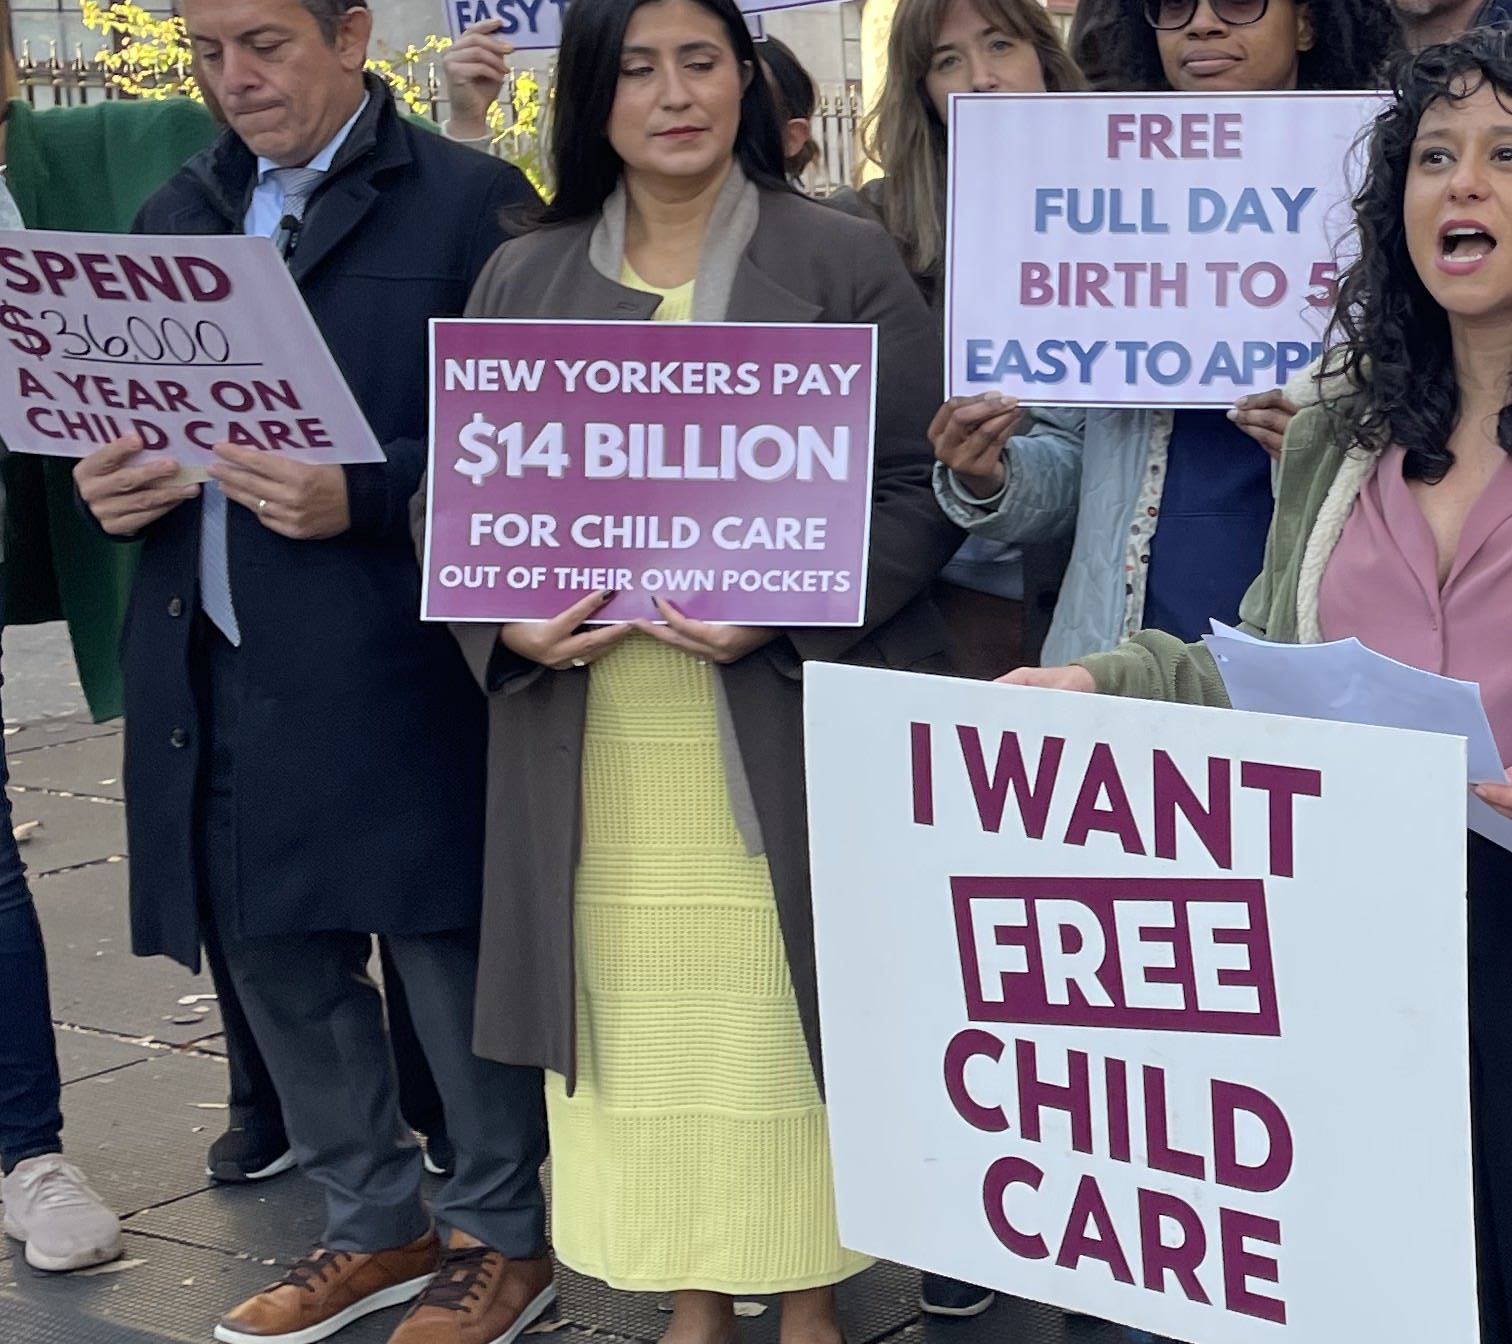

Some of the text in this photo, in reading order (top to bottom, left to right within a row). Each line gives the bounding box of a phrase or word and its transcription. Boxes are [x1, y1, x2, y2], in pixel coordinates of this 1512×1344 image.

[1107, 112, 1244, 160] FREE
[1034, 186, 1316, 235] FULL DAY
[0, 247, 232, 303] SPEND
[1020, 261, 1339, 309] BIRTH TO 5
[443, 358, 862, 397] NEW YORKERS PAY
[966, 338, 1108, 384] EASY
[1116, 340, 1191, 387] TO
[19, 367, 303, 413] A YEAR ON
[184, 418, 334, 451] CARE
[453, 412, 850, 486] $14 BILLION
[469, 512, 828, 550] FOR CHILD CARE
[438, 565, 851, 593] OUT OF THEIR OWN POCKETS
[910, 721, 1322, 879] I WANT
[968, 897, 1263, 1015] FREE
[943, 1028, 1295, 1194] CHILD
[982, 1156, 1288, 1326] CARE
